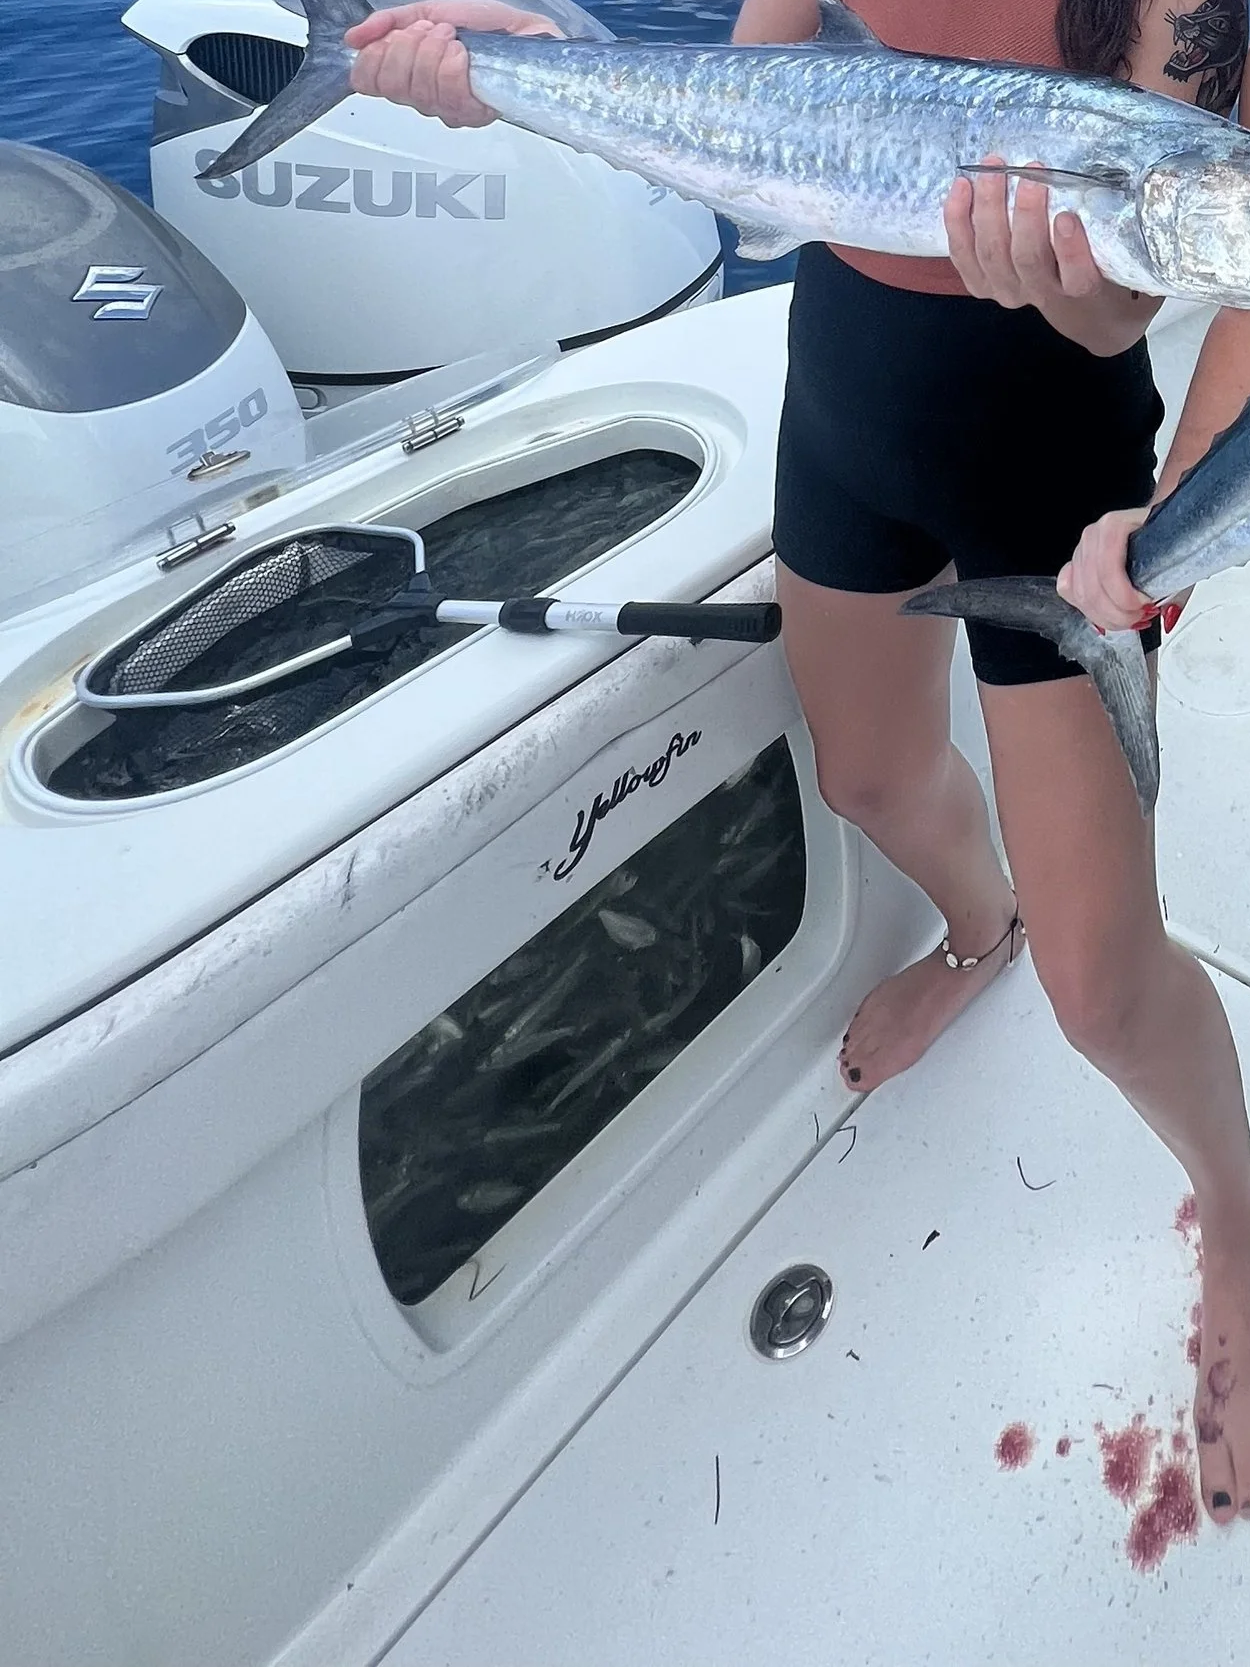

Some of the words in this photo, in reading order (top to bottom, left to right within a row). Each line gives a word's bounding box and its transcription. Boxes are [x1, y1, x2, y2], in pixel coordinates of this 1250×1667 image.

[194, 148, 507, 220] SUZUKI
[166, 387, 268, 475] 350
[554, 730, 702, 881] Yellowfin
